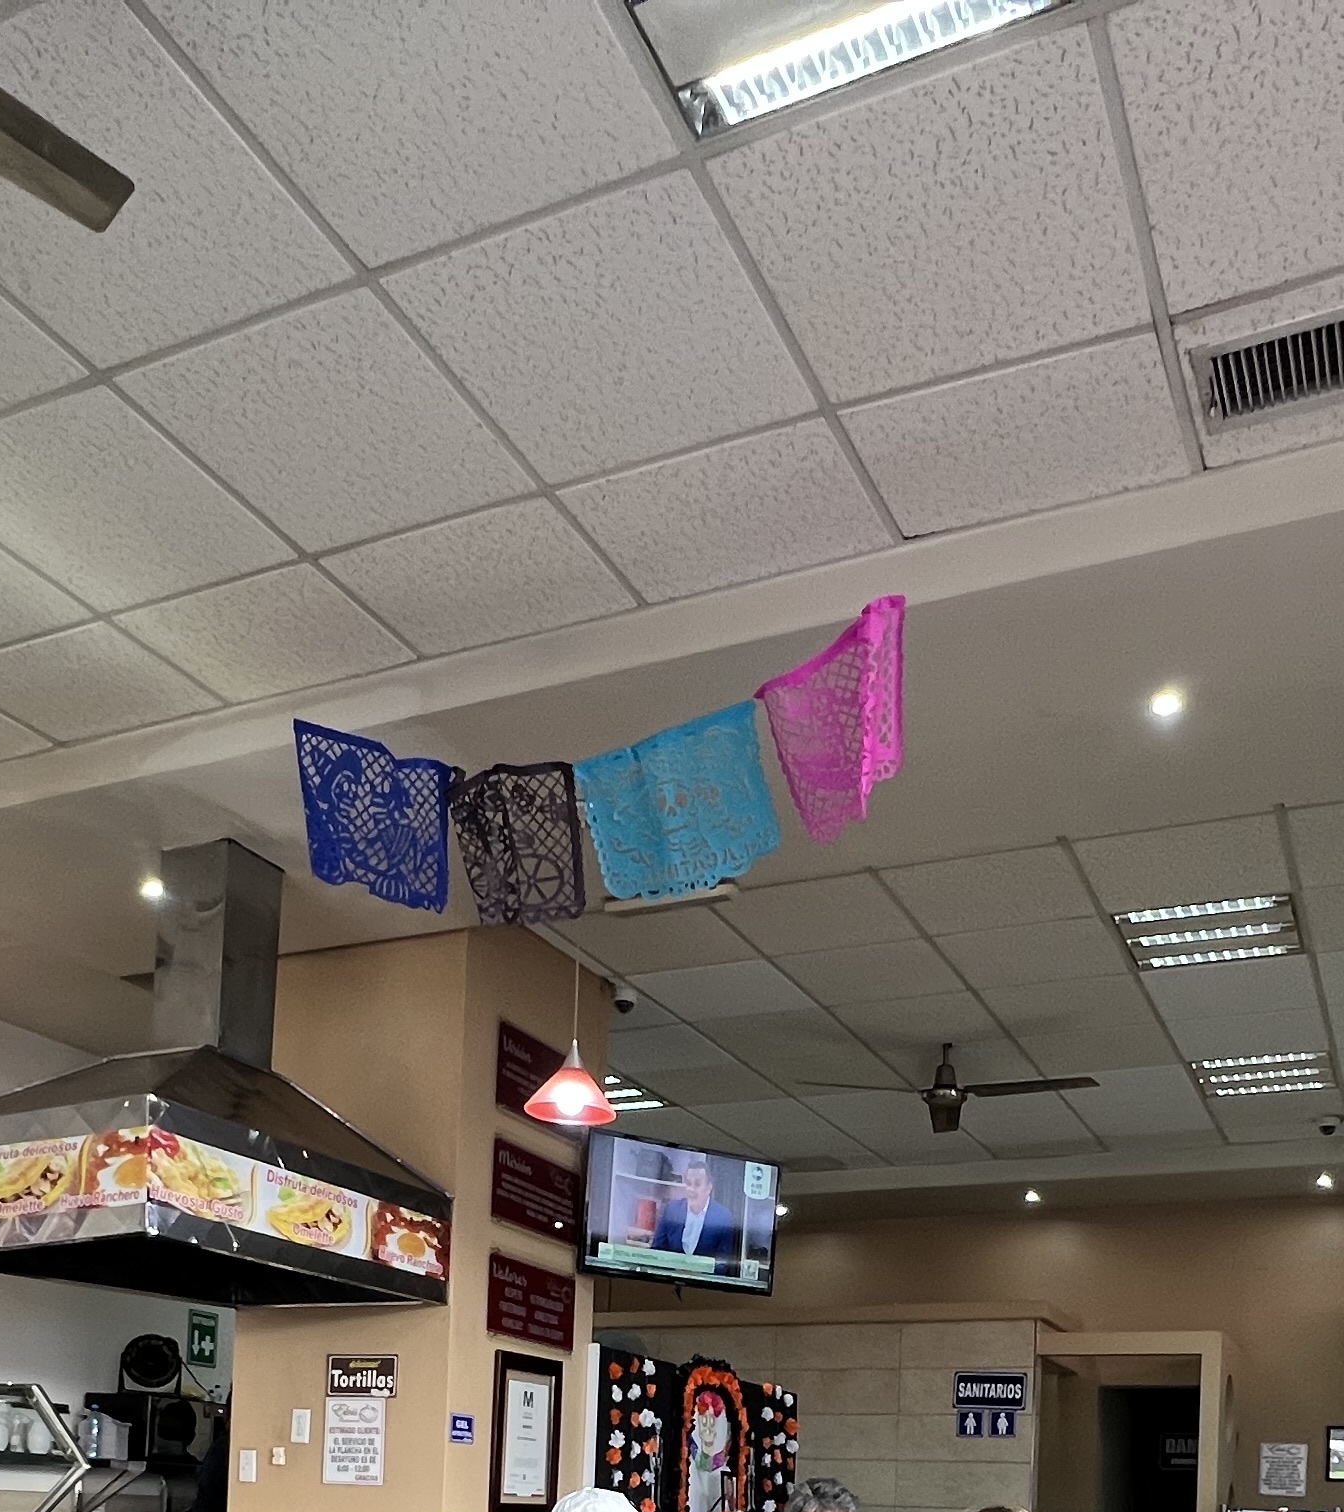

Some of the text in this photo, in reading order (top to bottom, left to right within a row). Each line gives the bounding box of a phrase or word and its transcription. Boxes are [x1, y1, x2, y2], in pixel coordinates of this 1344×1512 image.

[21, 1140, 78, 1158] deliciosos
[93, 1188, 140, 1204] Ranchero
[266, 1169, 359, 1210] Disfruta deliciosos
[151, 1185, 196, 1207] Huevos
[212, 1201, 244, 1220] Gusto
[292, 1223, 335, 1247] Omelette
[331, 1369, 395, 1388] Tortillas
[957, 1382, 1023, 1400] SANITARIOS
